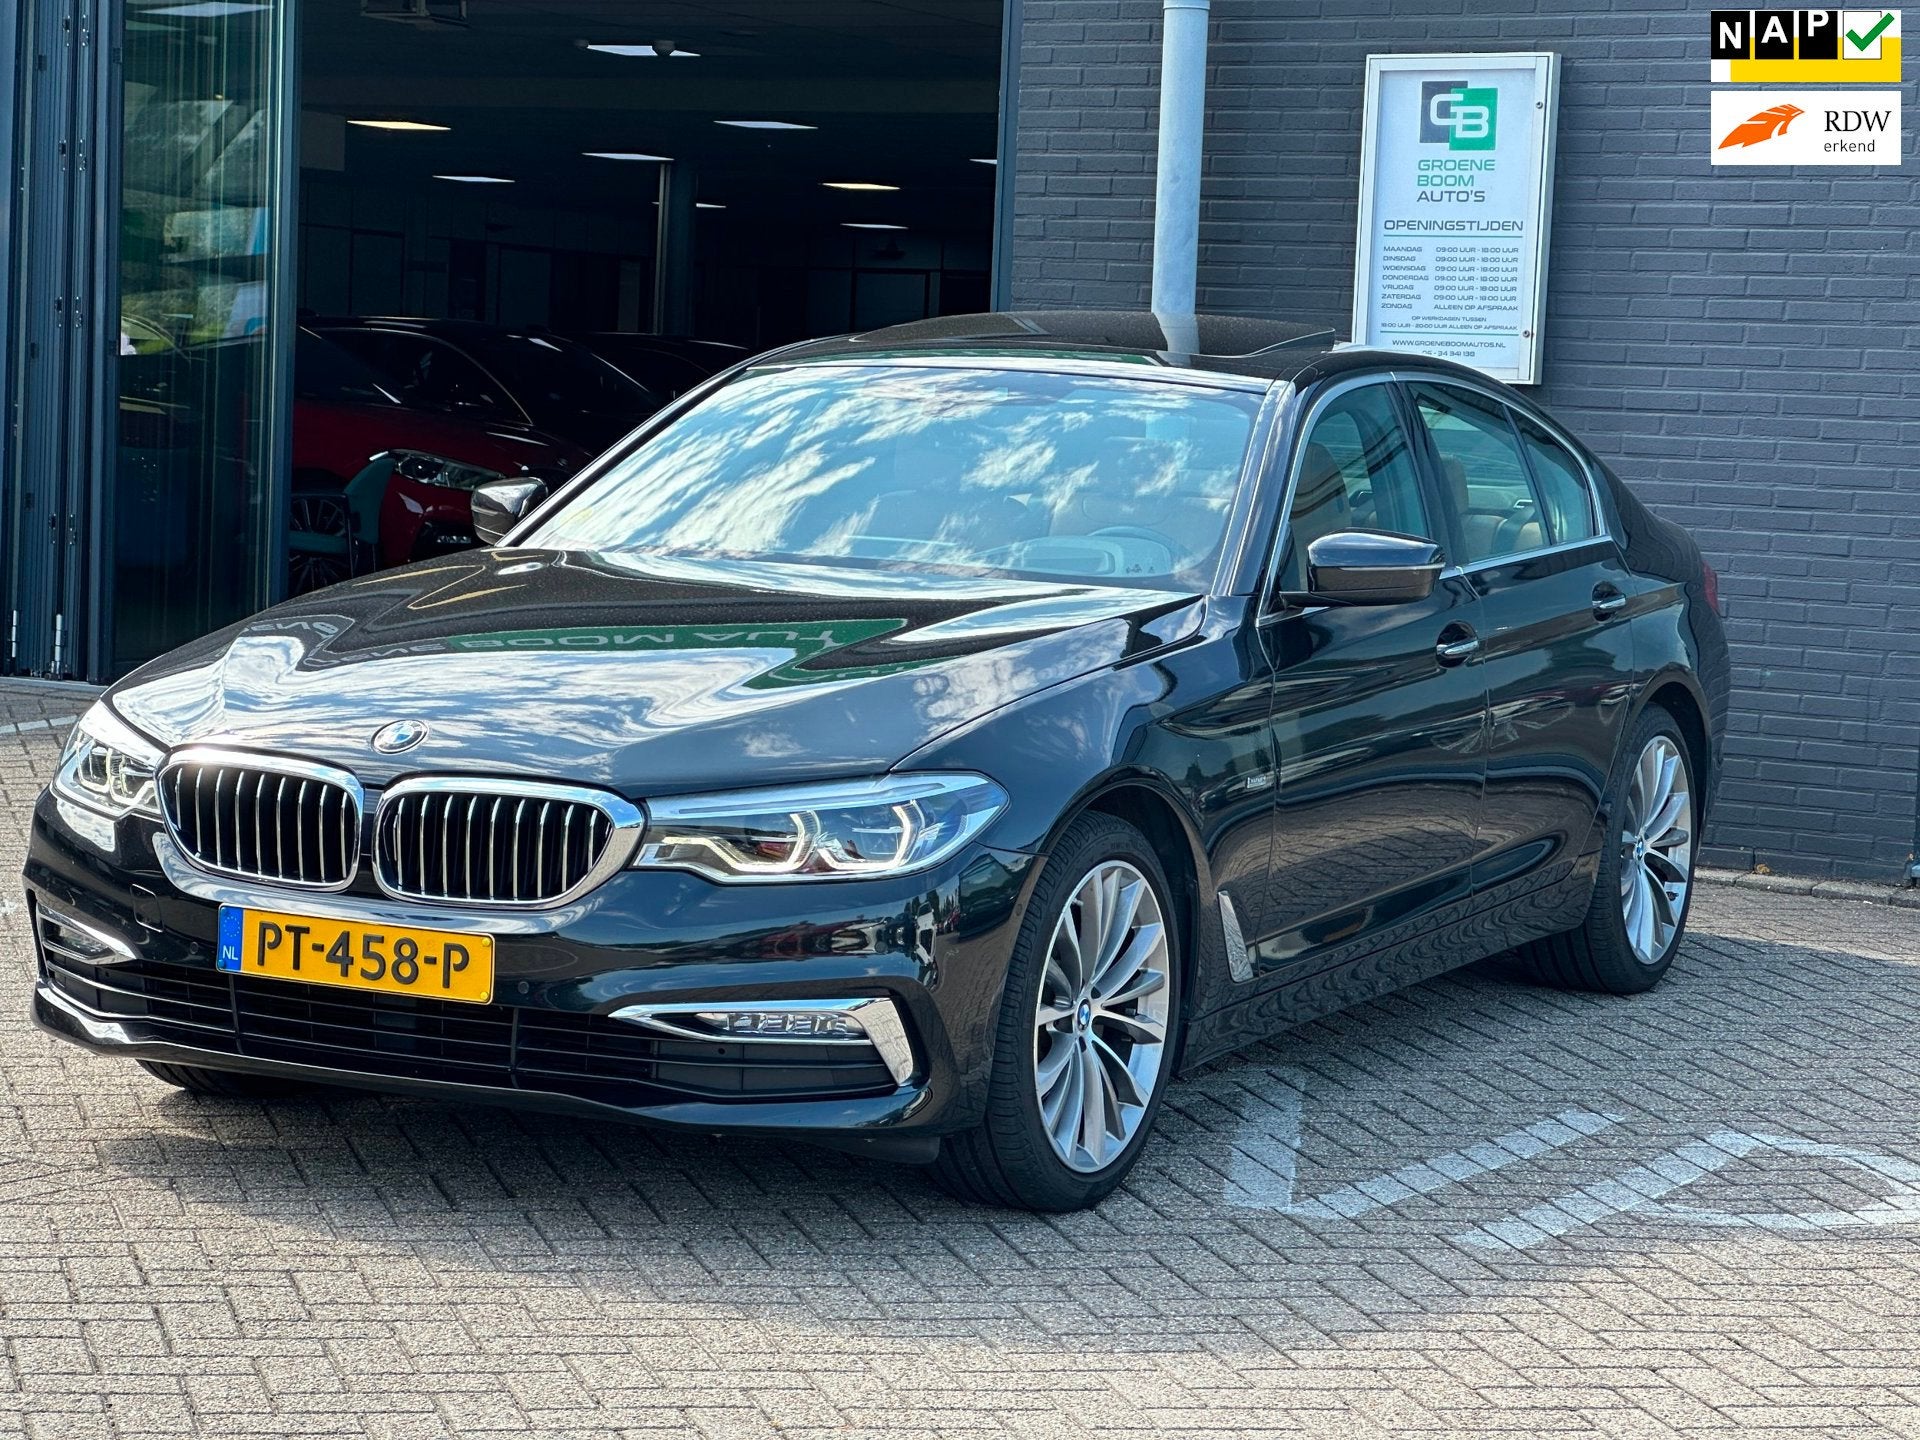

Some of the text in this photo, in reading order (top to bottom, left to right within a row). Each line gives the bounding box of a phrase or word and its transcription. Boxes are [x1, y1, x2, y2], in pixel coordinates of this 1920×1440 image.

[1418, 159, 1496, 171] GROENE
[1417, 175, 1475, 187] BOOM
[1416, 190, 1486, 203] AUTO'S
[1383, 219, 1524, 231] OPENINGSTIJDEN
[1392, 340, 1506, 348] WWW.GROENEBOOMAUTOS.NL
[222, 945, 239, 961] NL
[257, 920, 470, 989] PT-458-P
